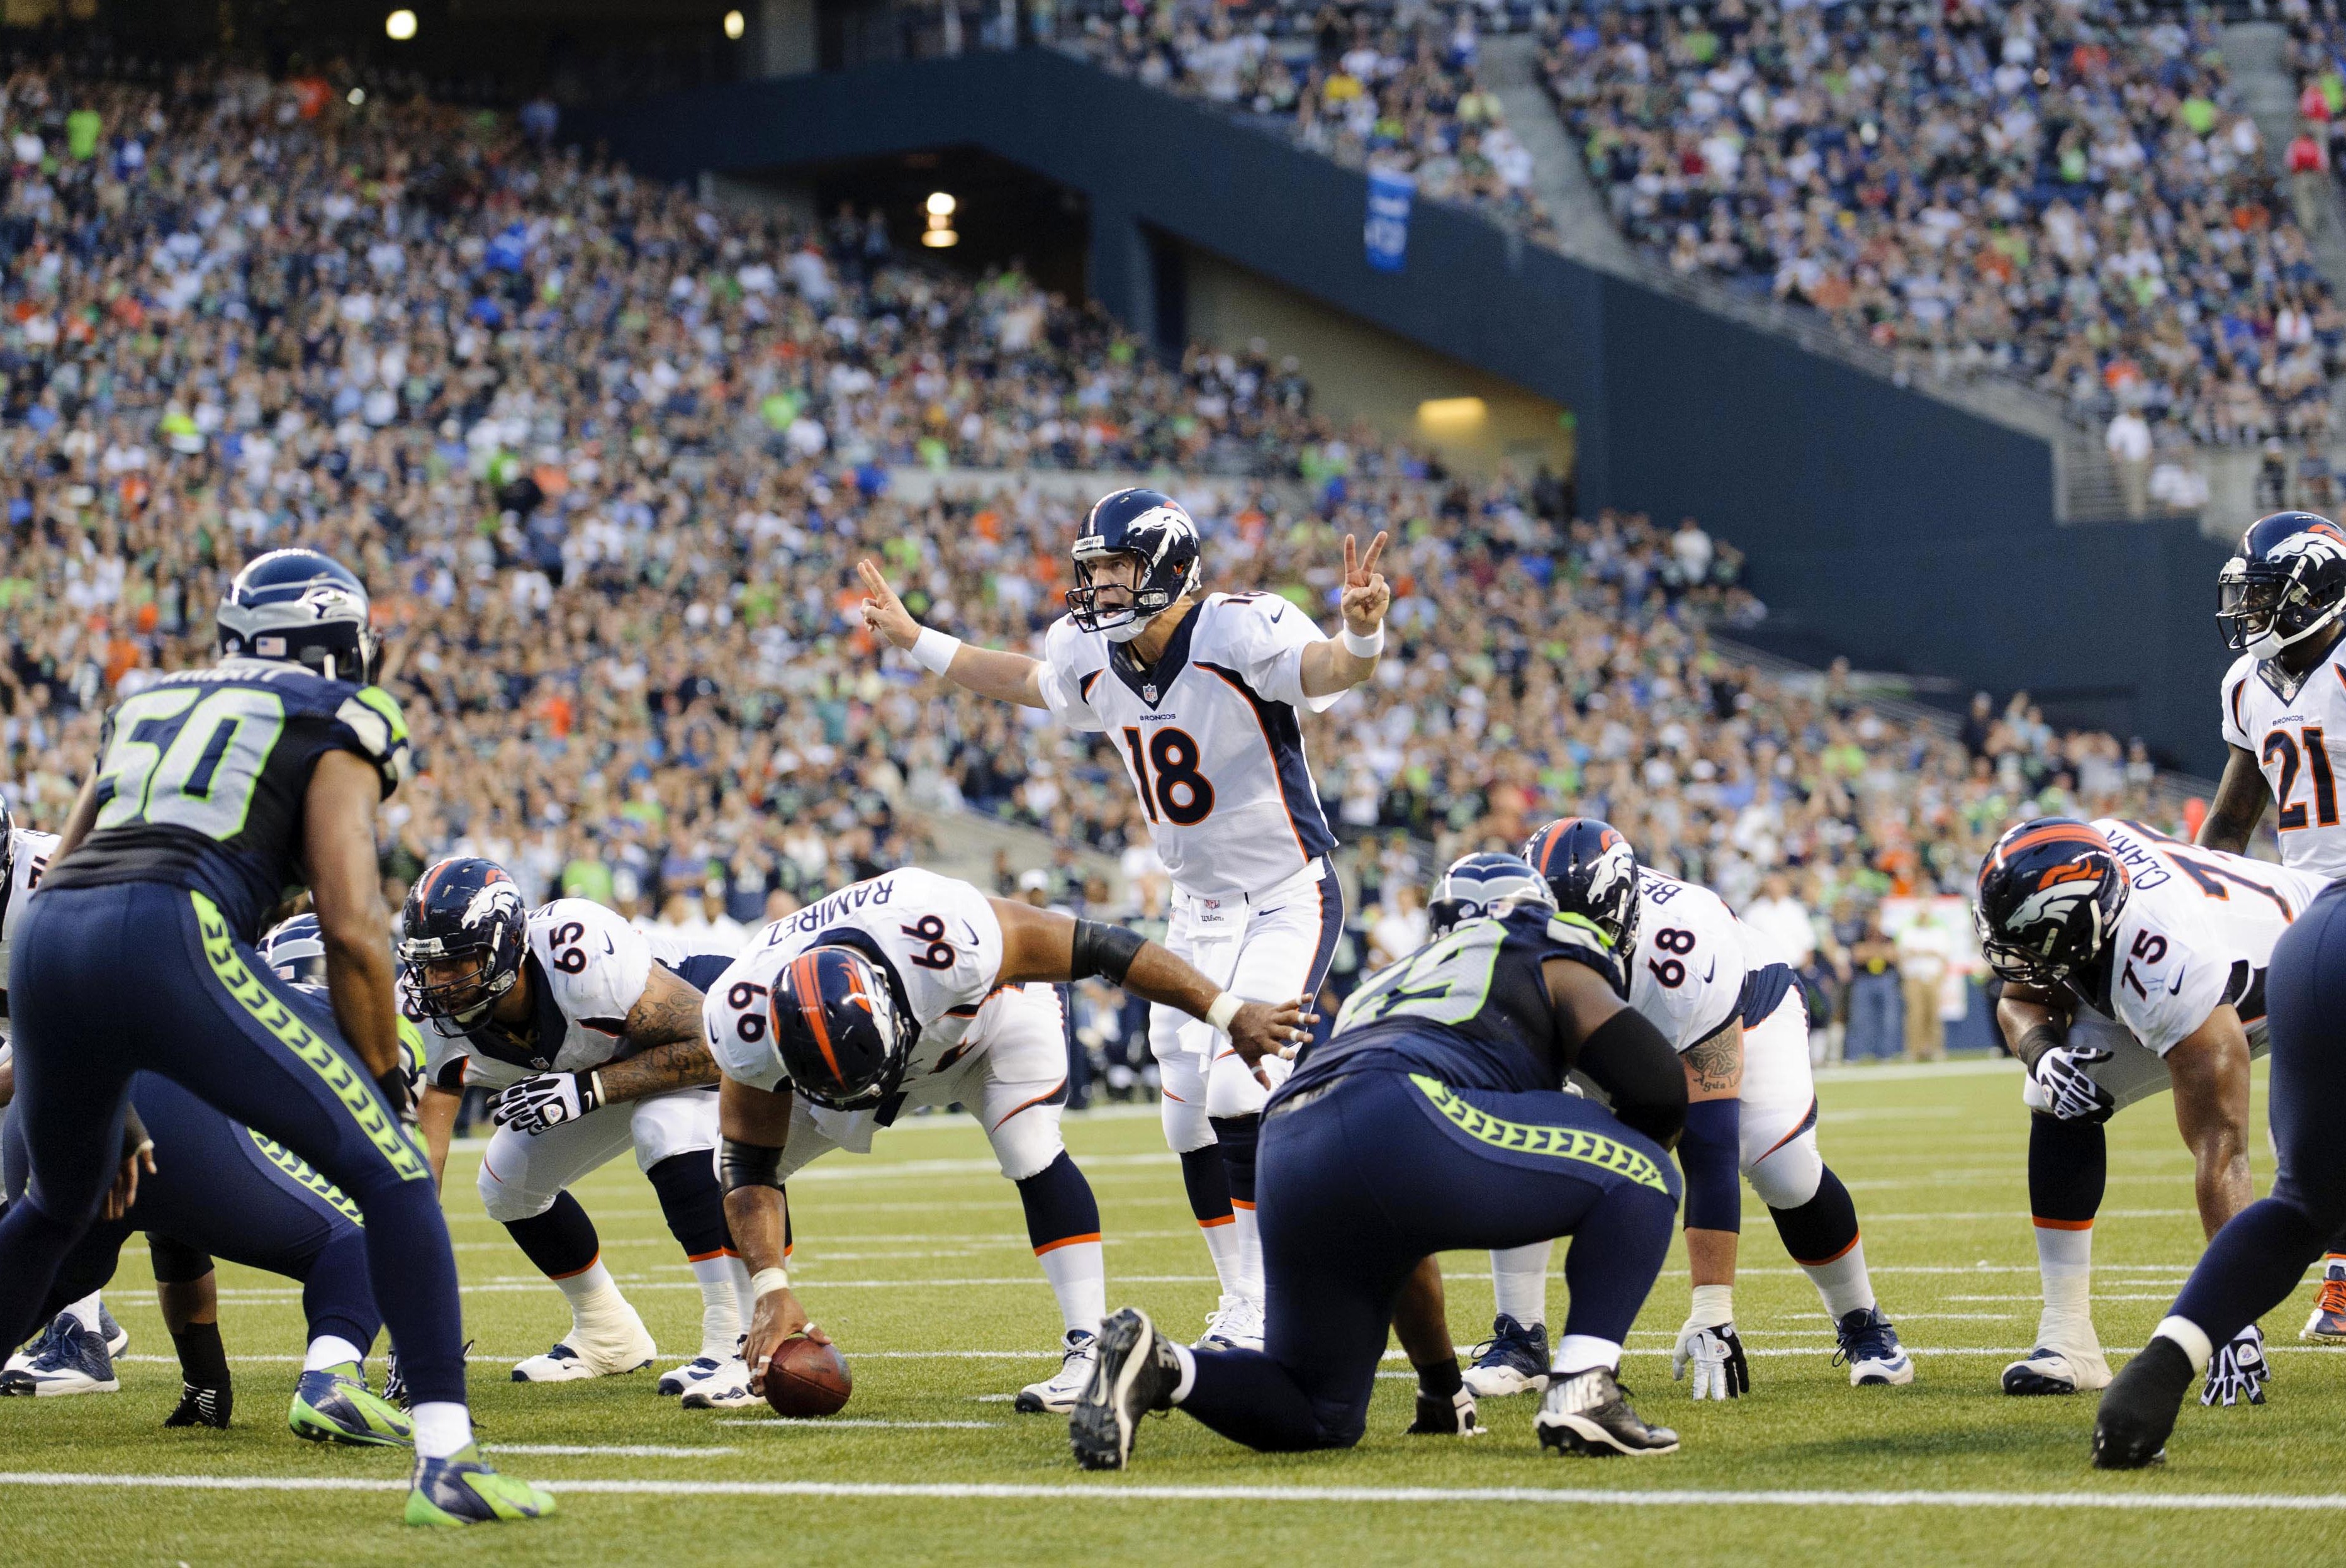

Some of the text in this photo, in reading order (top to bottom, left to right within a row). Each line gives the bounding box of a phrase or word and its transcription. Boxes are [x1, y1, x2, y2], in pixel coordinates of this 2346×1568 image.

[2272, 715, 2304, 727] BRONCOS
[93, 686, 286, 841] 50
[1122, 726, 1215, 826] 18
[2262, 726, 2340, 832] 21
[767, 879, 894, 946] RAMIREZ
[899, 914, 956, 970] 66
[549, 921, 586, 975] 65
[1647, 927, 1696, 989] 68
[2121, 927, 2169, 1002] 75
[728, 981, 768, 1043] 66
[1547, 1370, 1605, 1414] NIKE
